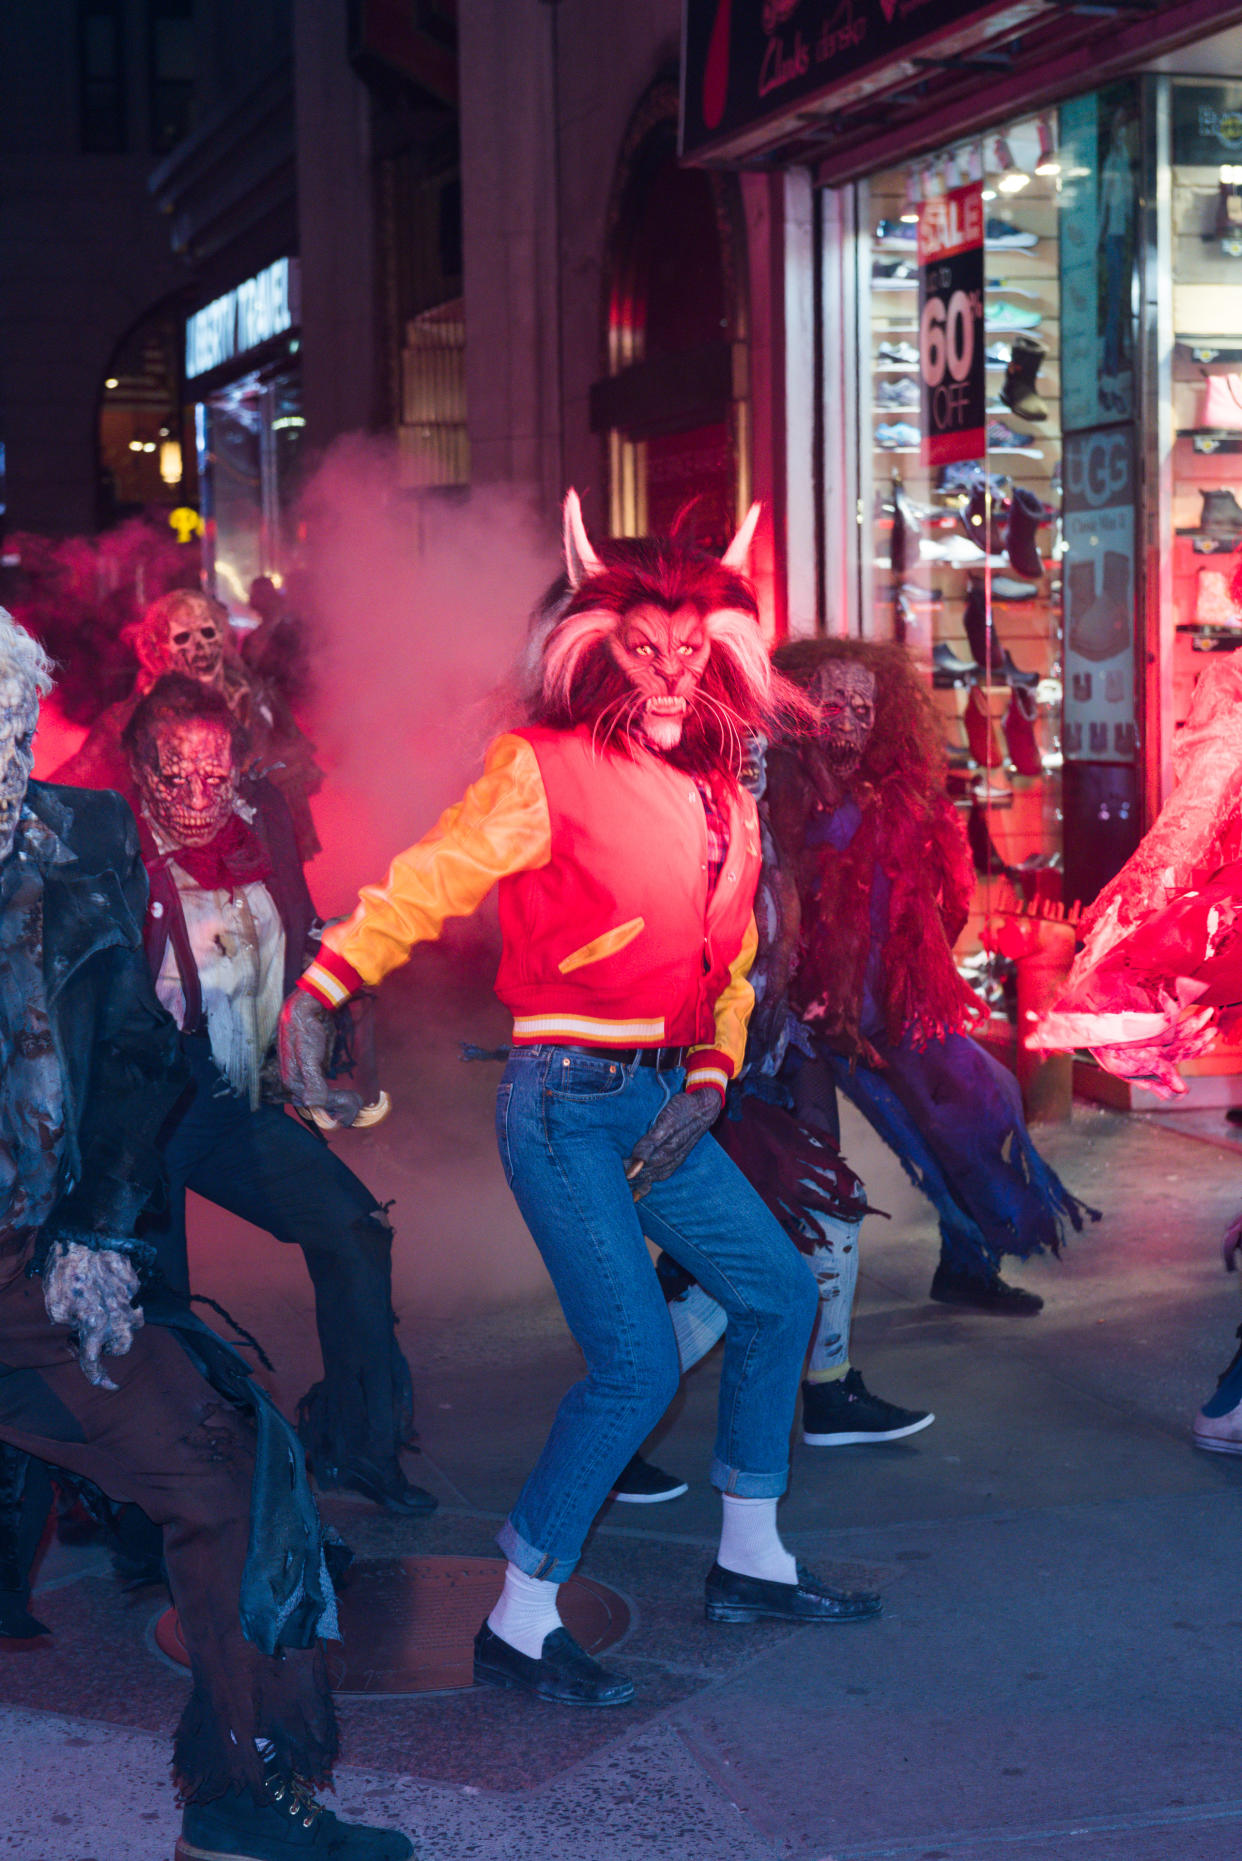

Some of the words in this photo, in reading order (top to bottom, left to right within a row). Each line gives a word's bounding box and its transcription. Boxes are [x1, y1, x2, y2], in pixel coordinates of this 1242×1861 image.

[920, 193, 981, 256] SALE
[933, 381, 971, 430] OFF
[1066, 432, 1128, 507] UGG
